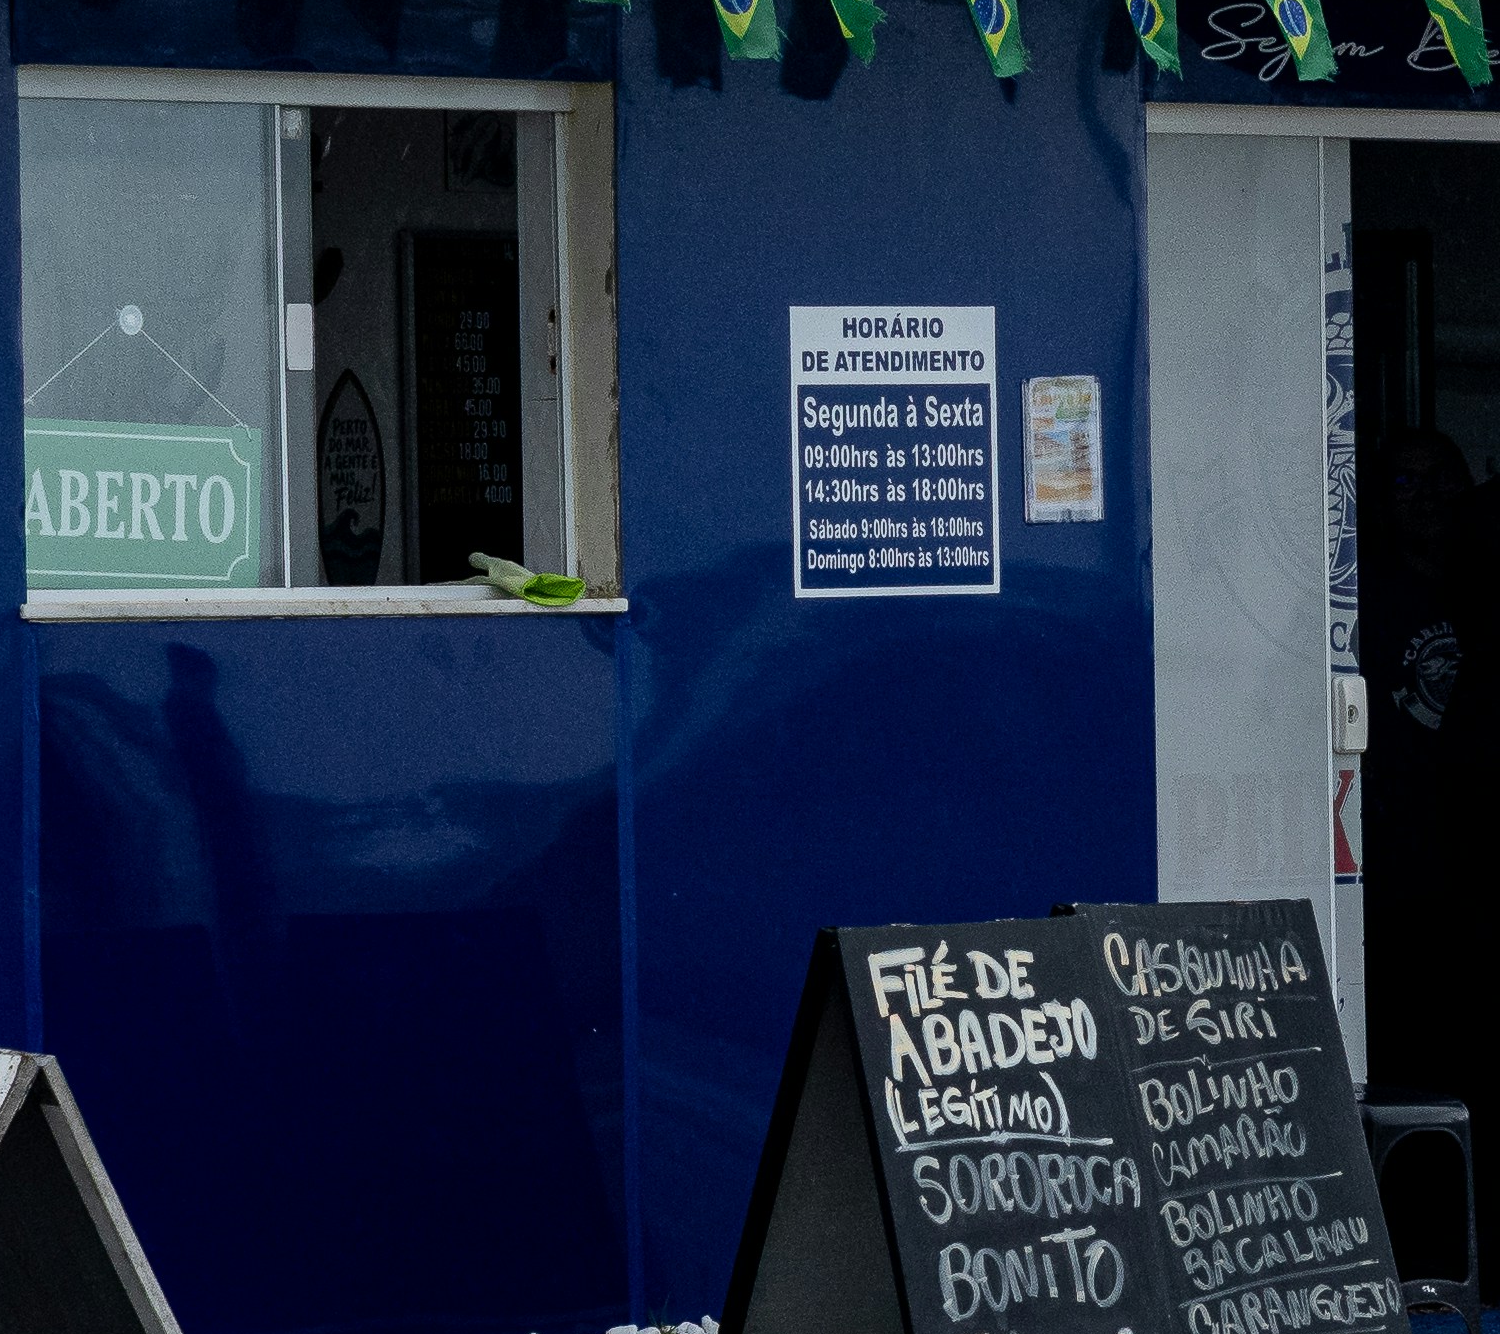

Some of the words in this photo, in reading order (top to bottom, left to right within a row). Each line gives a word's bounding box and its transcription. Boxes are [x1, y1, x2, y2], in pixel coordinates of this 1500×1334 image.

[842, 313, 944, 339] HORÁRIO
[801, 350, 829, 372] DE
[834, 349, 985, 372] ATENDIMENTO
[803, 396, 898, 436] Segunda
[906, 395, 918, 427] à
[925, 395, 984, 427] Sexta
[804, 444, 878, 469] 09:00hrs
[886, 444, 906, 467] às
[912, 444, 984, 467] 13:00hrs
[25, 470, 236, 545] ABERTO
[805, 479, 879, 503] 14:30hrs
[886, 478, 906, 502] às
[912, 478, 985, 501] 18:00hrs
[809, 518, 858, 540] Sábado
[861, 518, 908, 539] 9:00hrs
[912, 517, 927, 538] às
[930, 517, 984, 538] 18:00hrs
[807, 548, 865, 574] Domingo
[868, 548, 915, 568] 8:00hrs
[918, 548, 932, 568] às
[936, 547, 990, 567] 13:00hrs
[966, 950, 1035, 1000] DE
[889, 998, 1098, 1088] ABADEJO
[1128, 1006, 1180, 1045] DE
[912, 1152, 1141, 1225] SOROROCA
[1159, 1178, 1319, 1248] BOLINHO
[1182, 1216, 1369, 1290] BACALHAU
